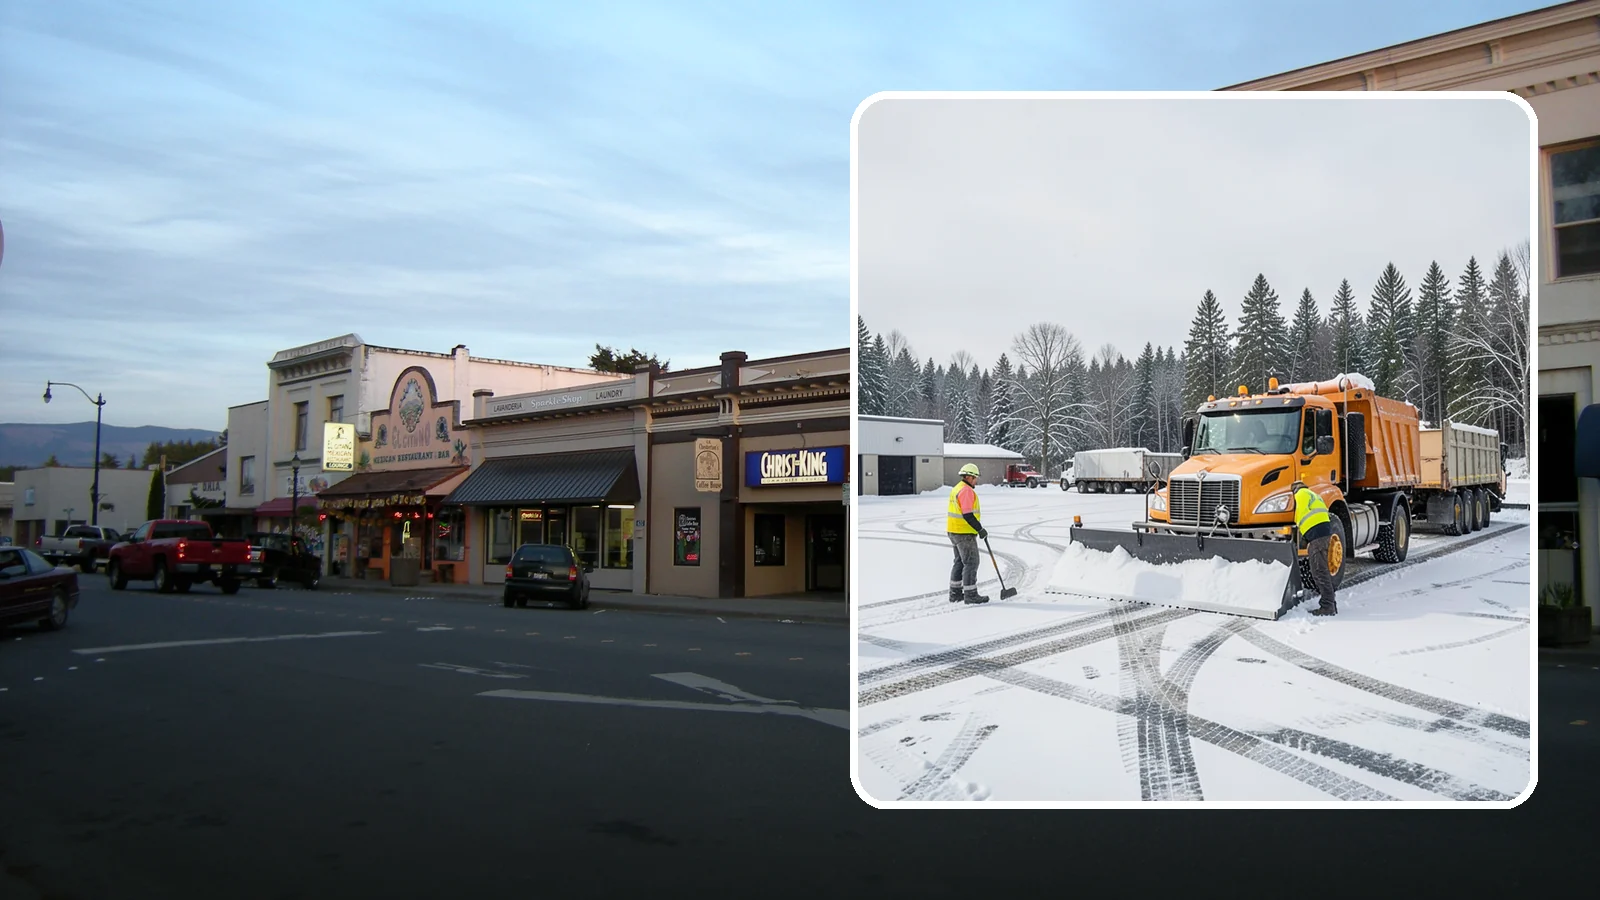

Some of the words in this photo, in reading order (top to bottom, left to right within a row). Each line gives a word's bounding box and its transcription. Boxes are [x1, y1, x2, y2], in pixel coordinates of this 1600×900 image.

[494, 402, 523, 412] LAVANDERIA
[530, 396, 561, 409] Sparkle
[562, 394, 583, 405] Shop
[595, 388, 624, 400] LAUNDRY
[373, 454, 396, 465] MEXICAN
[397, 451, 433, 463] RESTAURANT
[438, 450, 450, 459] BAR
[760, 451, 798, 478] CHRIST
[799, 449, 827, 476] KING
